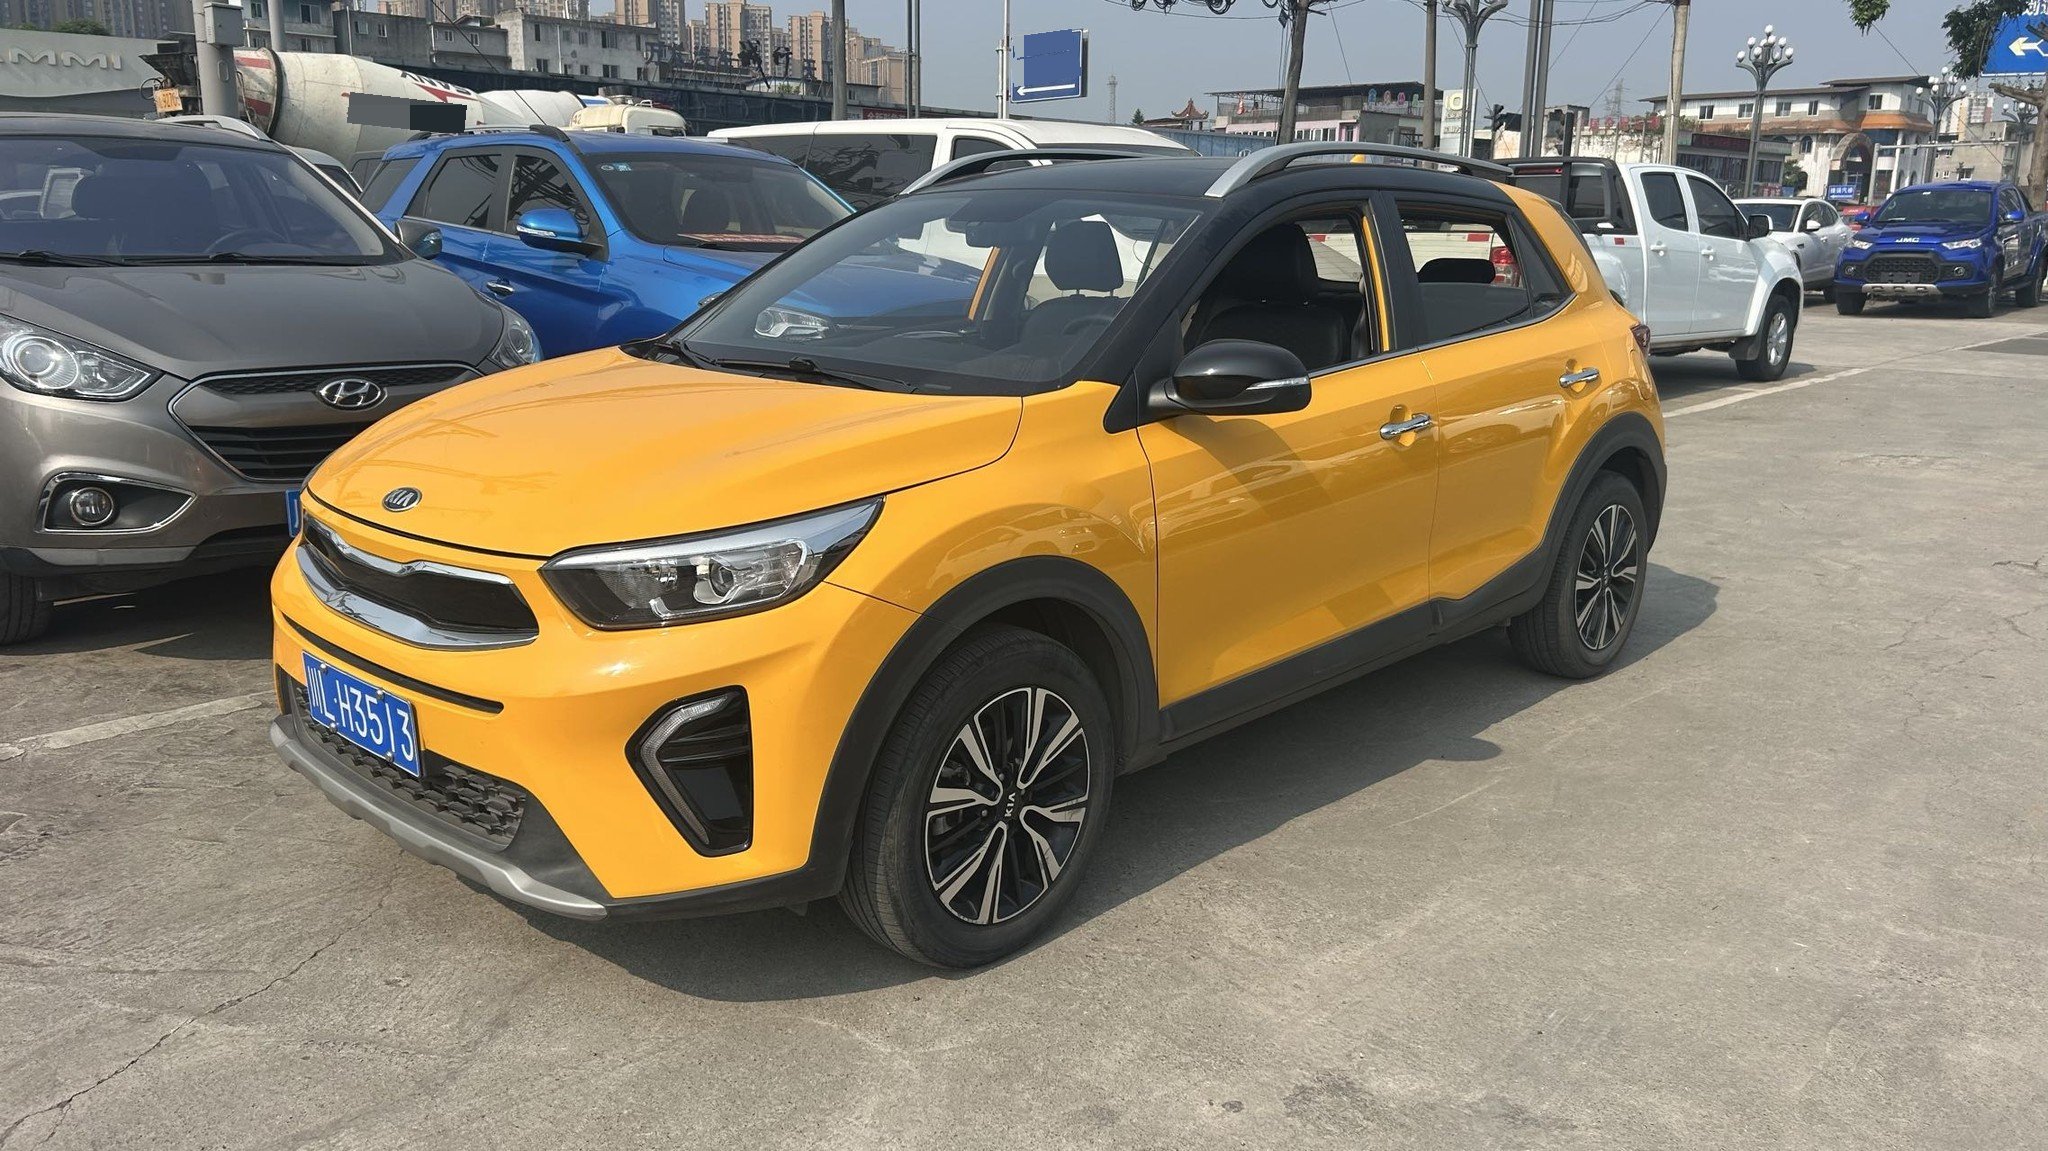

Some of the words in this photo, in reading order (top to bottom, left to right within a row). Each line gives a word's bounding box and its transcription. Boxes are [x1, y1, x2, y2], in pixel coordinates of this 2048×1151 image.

[0, 48, 121, 70] MMI
[385, 489, 415, 507] KIA
[1004, 792, 1016, 817] KIA
